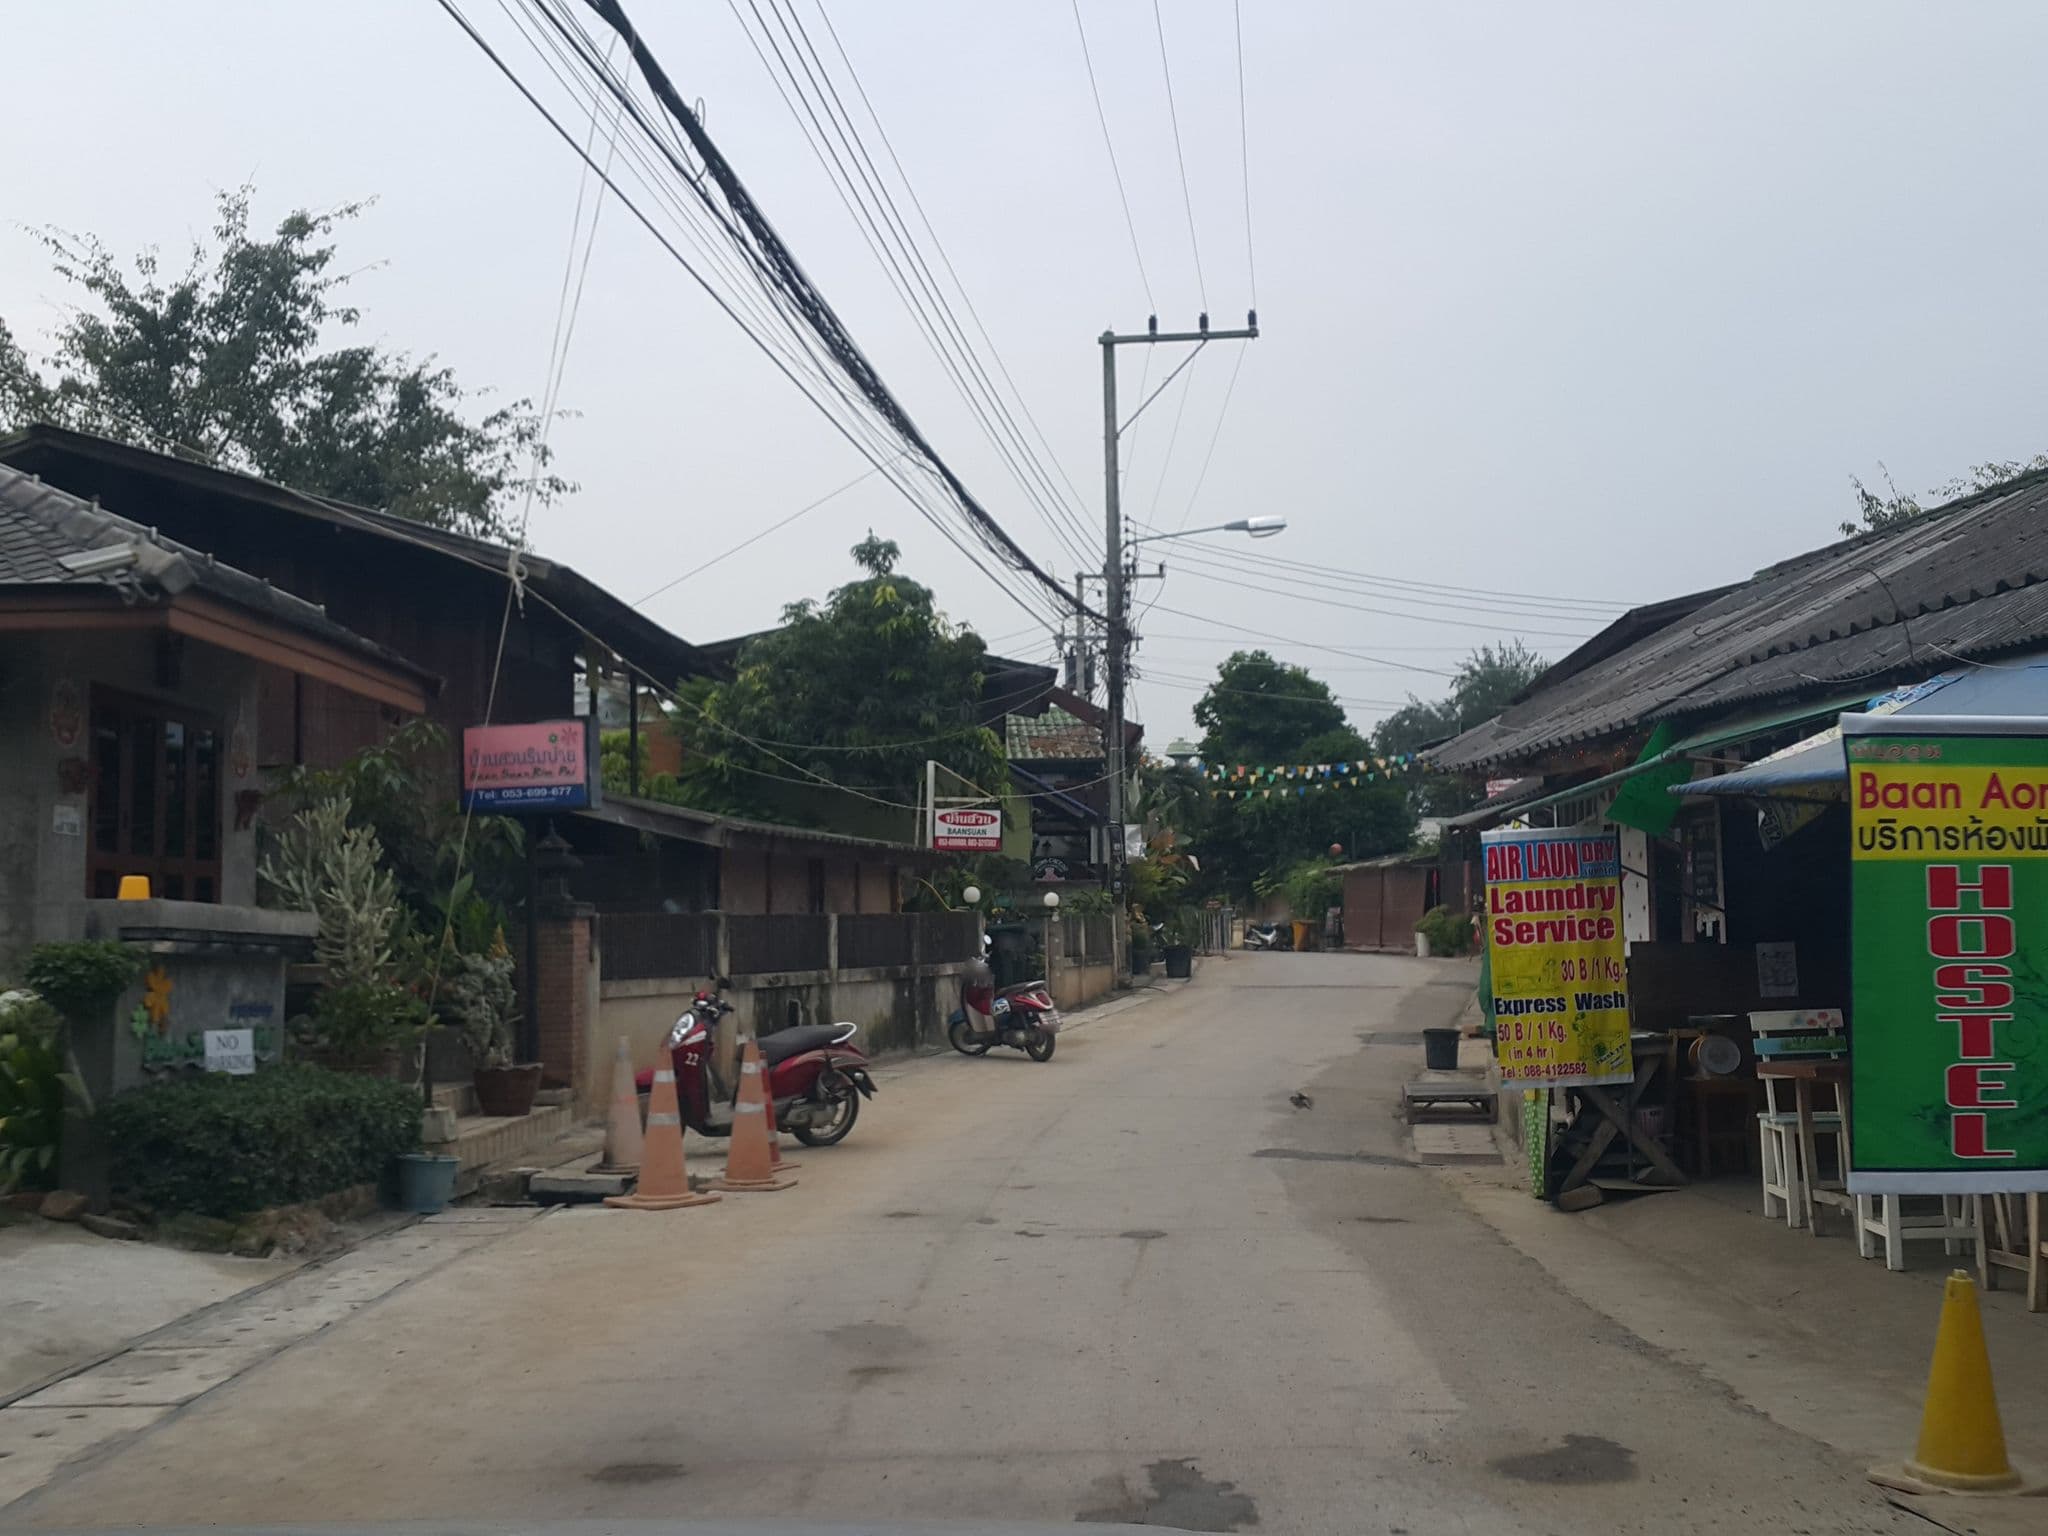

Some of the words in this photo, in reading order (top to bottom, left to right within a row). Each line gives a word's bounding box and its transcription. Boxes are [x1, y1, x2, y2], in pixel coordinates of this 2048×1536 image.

[1859, 771, 1962, 810] Baan
[947, 827, 987, 836] BAANSUAN
[1486, 845, 1523, 882] AIR
[1489, 882, 1617, 915] Laundry
[1493, 914, 1616, 947] Service
[1561, 959, 1575, 982] 30
[1578, 957, 1588, 981] B
[1604, 955, 1624, 984] Kg.
[1494, 996, 1567, 1017] Express
[1574, 990, 1627, 1012] Wash
[1926, 865, 2018, 1158] HOSTEL
[216, 1035, 240, 1050] NO
[1497, 1023, 1511, 1043] 50
[1514, 1022, 1524, 1042] B
[1548, 1019, 1568, 1044] Kg.
